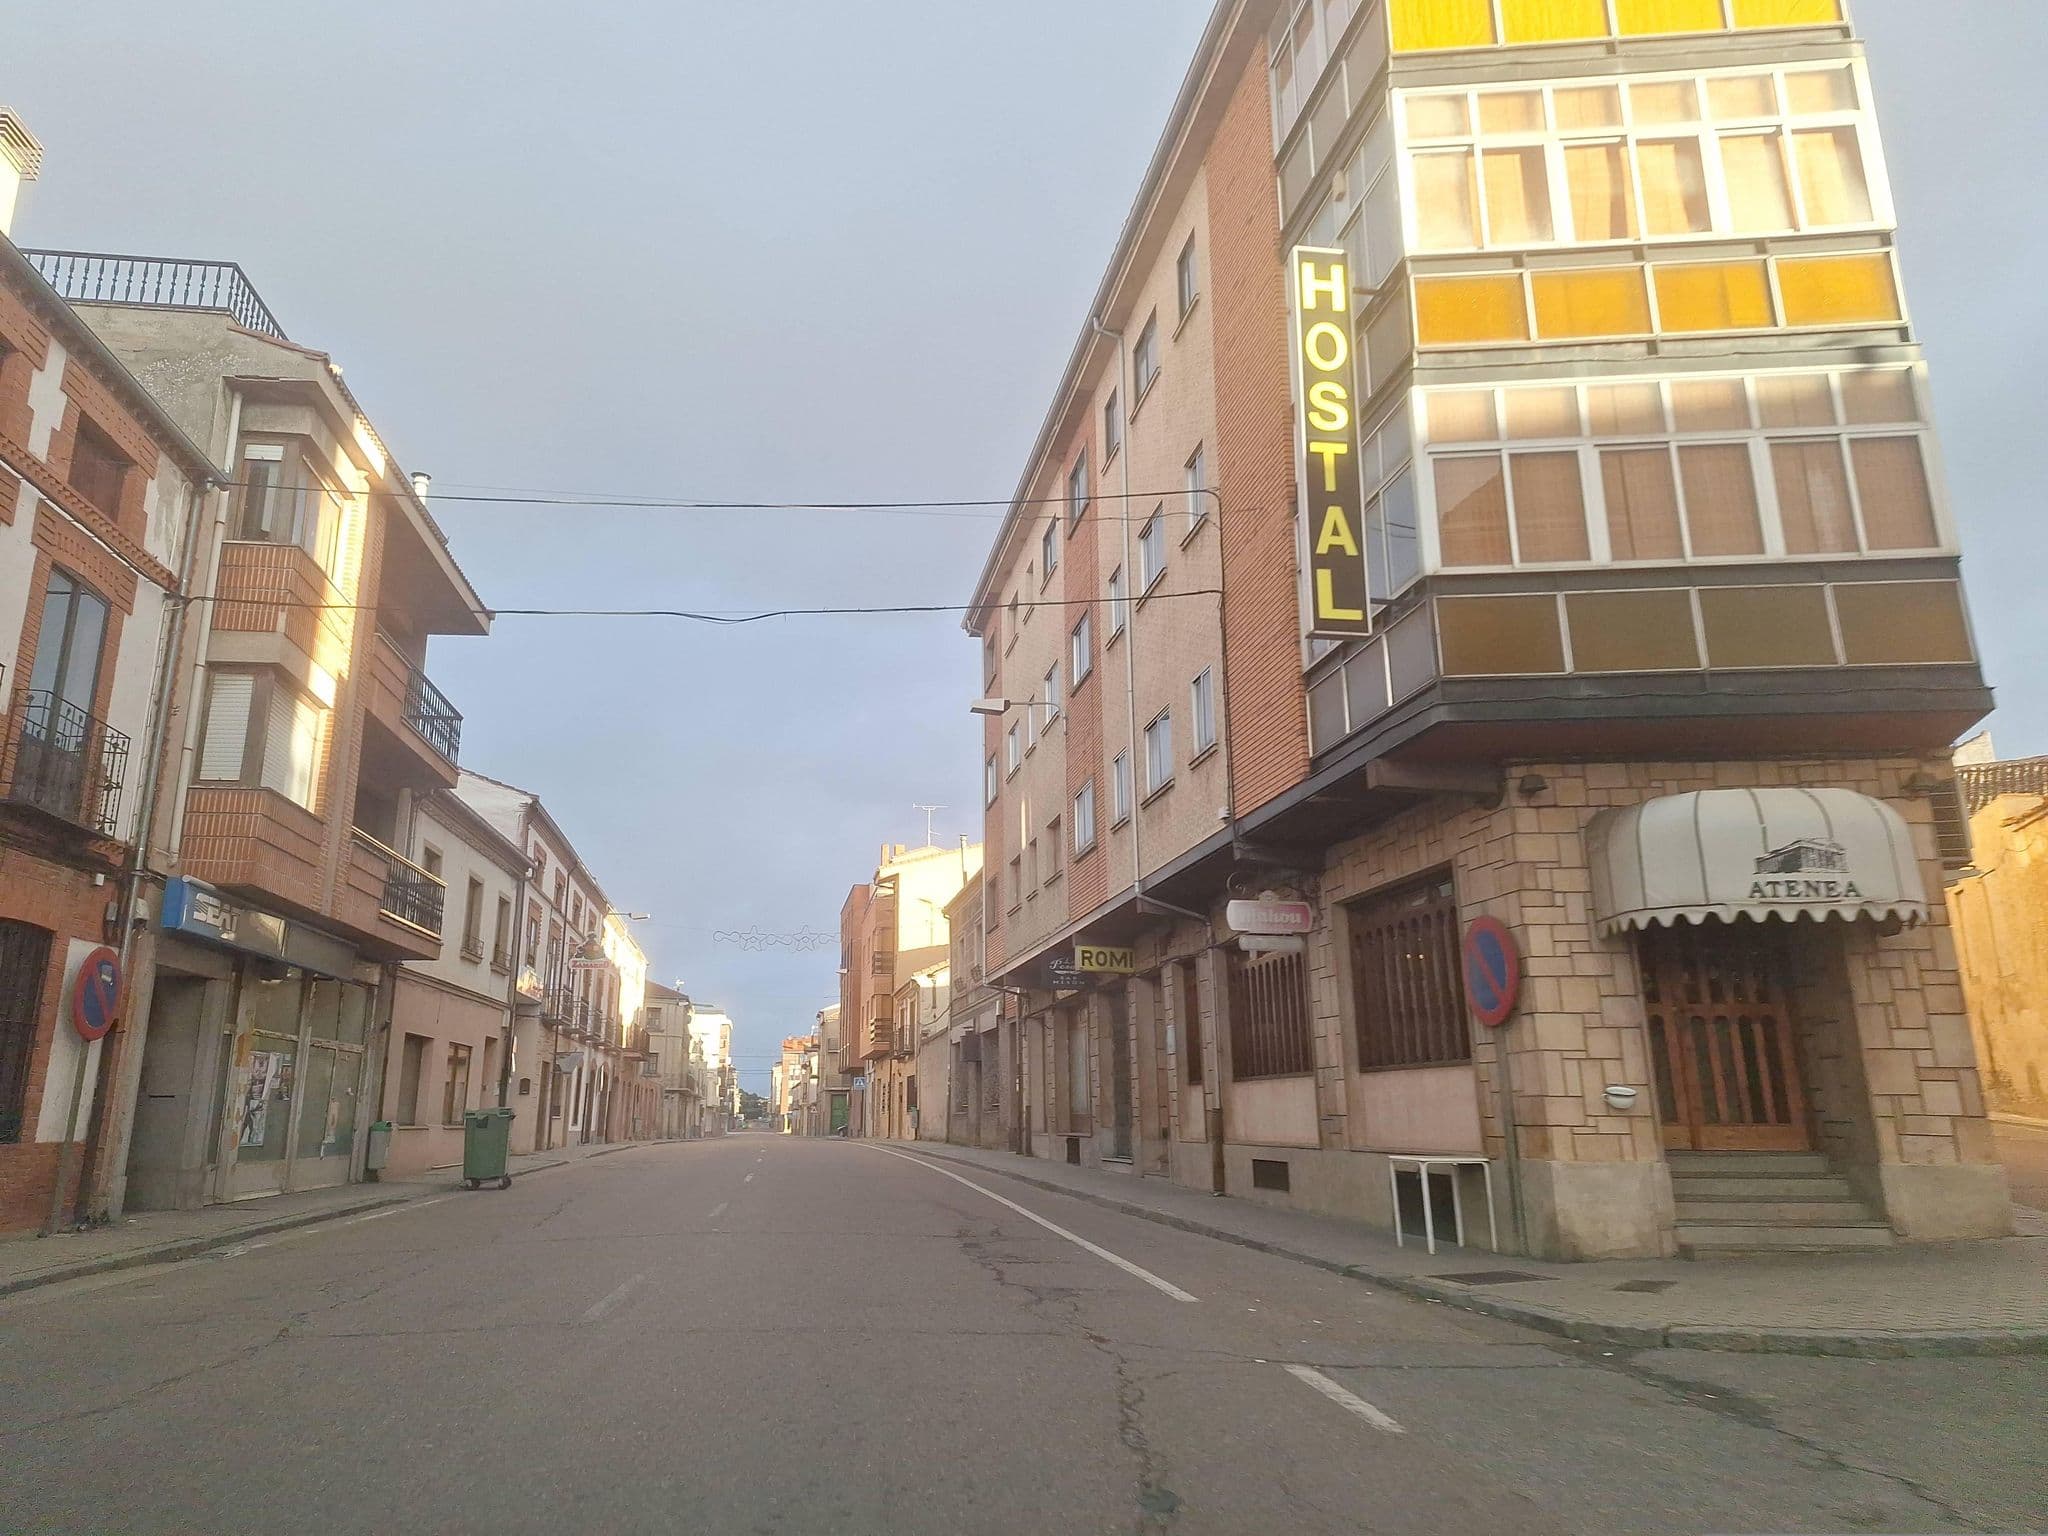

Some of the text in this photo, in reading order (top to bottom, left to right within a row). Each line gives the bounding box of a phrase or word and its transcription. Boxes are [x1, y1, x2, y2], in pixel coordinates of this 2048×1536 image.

[1301, 261, 1363, 621] HOSTAL
[1748, 880, 1863, 899] ATENEA
[193, 893, 241, 933] SEAT
[1081, 949, 1134, 969] ROMI
